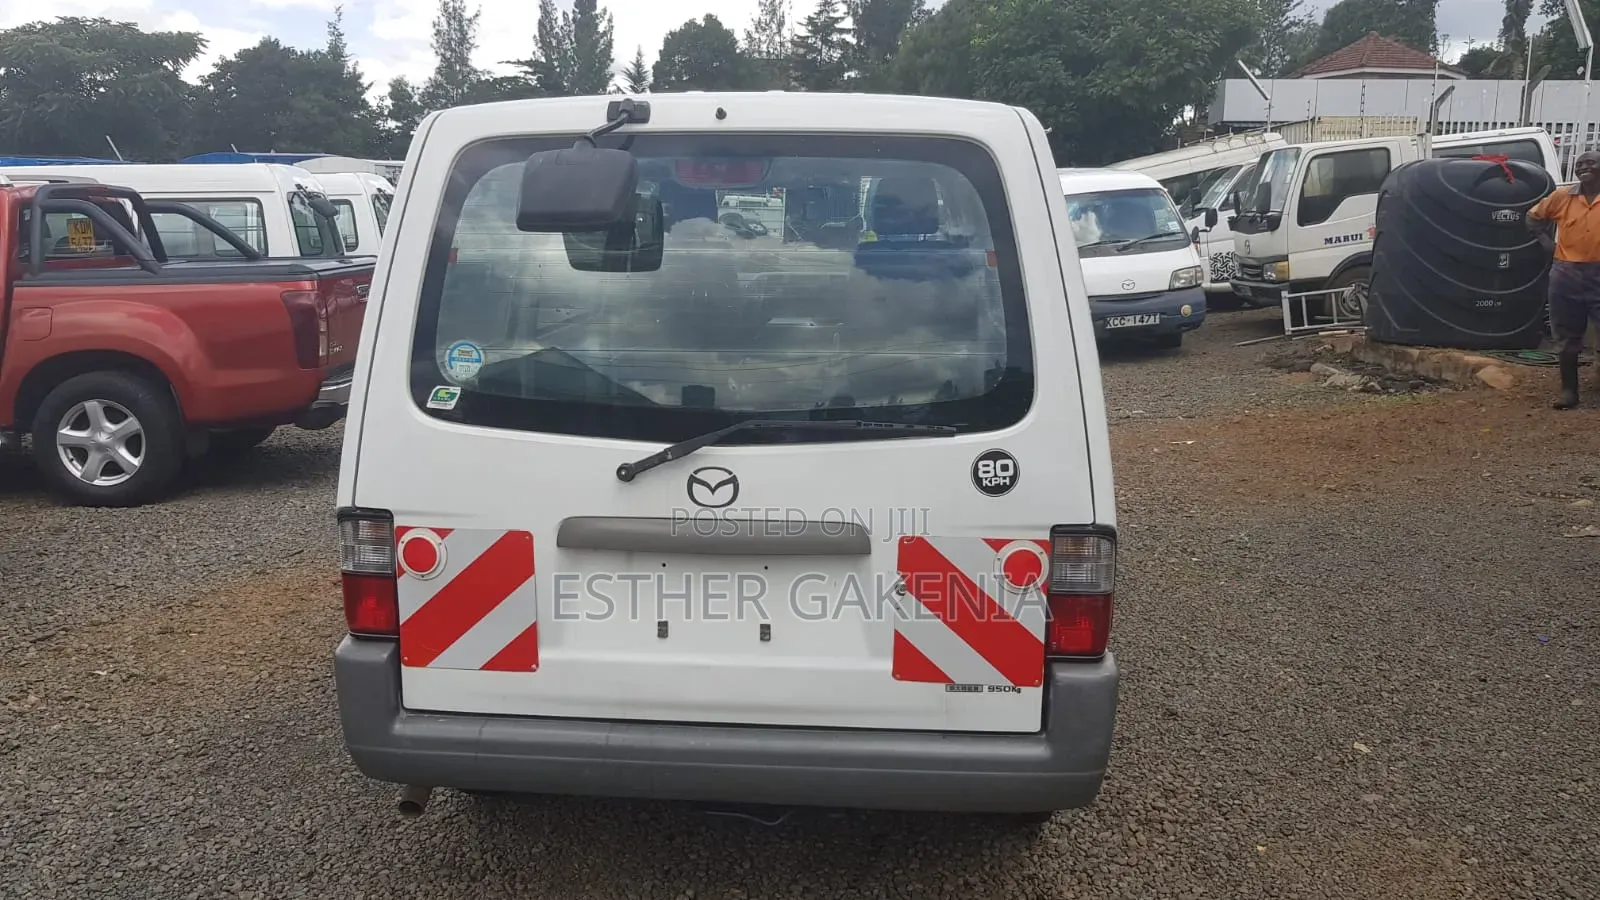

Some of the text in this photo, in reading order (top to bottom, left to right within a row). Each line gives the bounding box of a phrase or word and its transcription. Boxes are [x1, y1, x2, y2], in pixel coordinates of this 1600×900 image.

[1491, 212, 1521, 221] VECTUS
[1105, 314, 1159, 328] KCC 147T
[978, 459, 1014, 478] 80
[982, 477, 1010, 487] KPH
